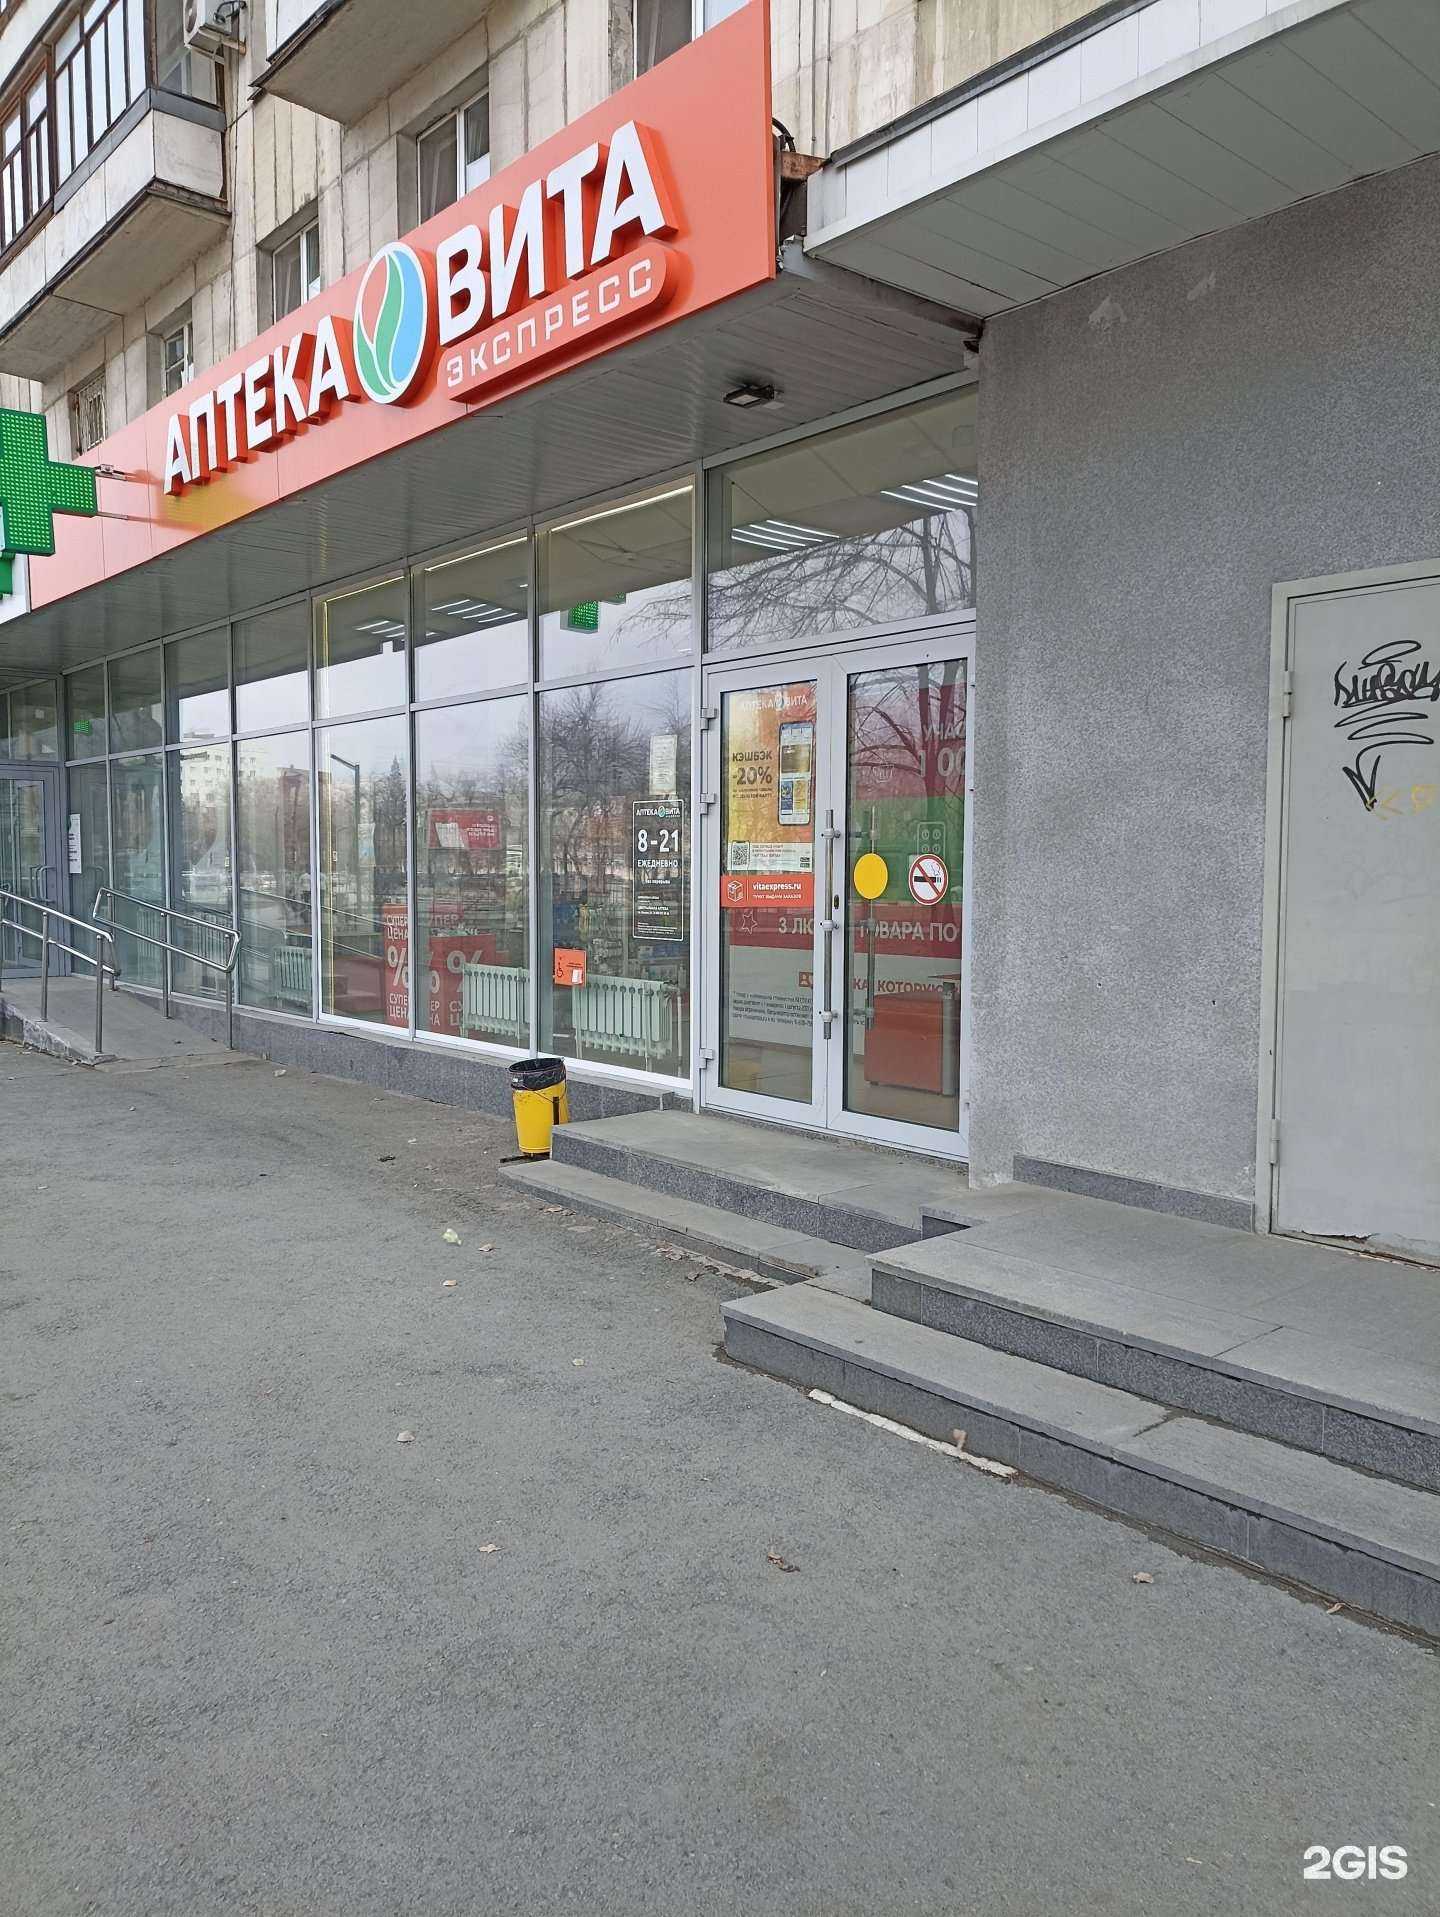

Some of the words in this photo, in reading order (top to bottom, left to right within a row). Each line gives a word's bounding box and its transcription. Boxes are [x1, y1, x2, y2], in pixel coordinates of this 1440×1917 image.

[163, 314, 353, 496] АПТЕКА
[435, 119, 666, 346] ВИТА
[446, 258, 653, 389] ЭКСПРЕСС
[732, 750, 773, 762] КЭШБЭК
[637, 859, 679, 869] ЕЖЕДНЕВНО
[752, 881, 802, 892] vitaexpress.ru
[929, 922, 958, 942] ПО
[389, 992, 408, 1005] СУПЕ
[388, 1005, 409, 1021] ЦЕН
